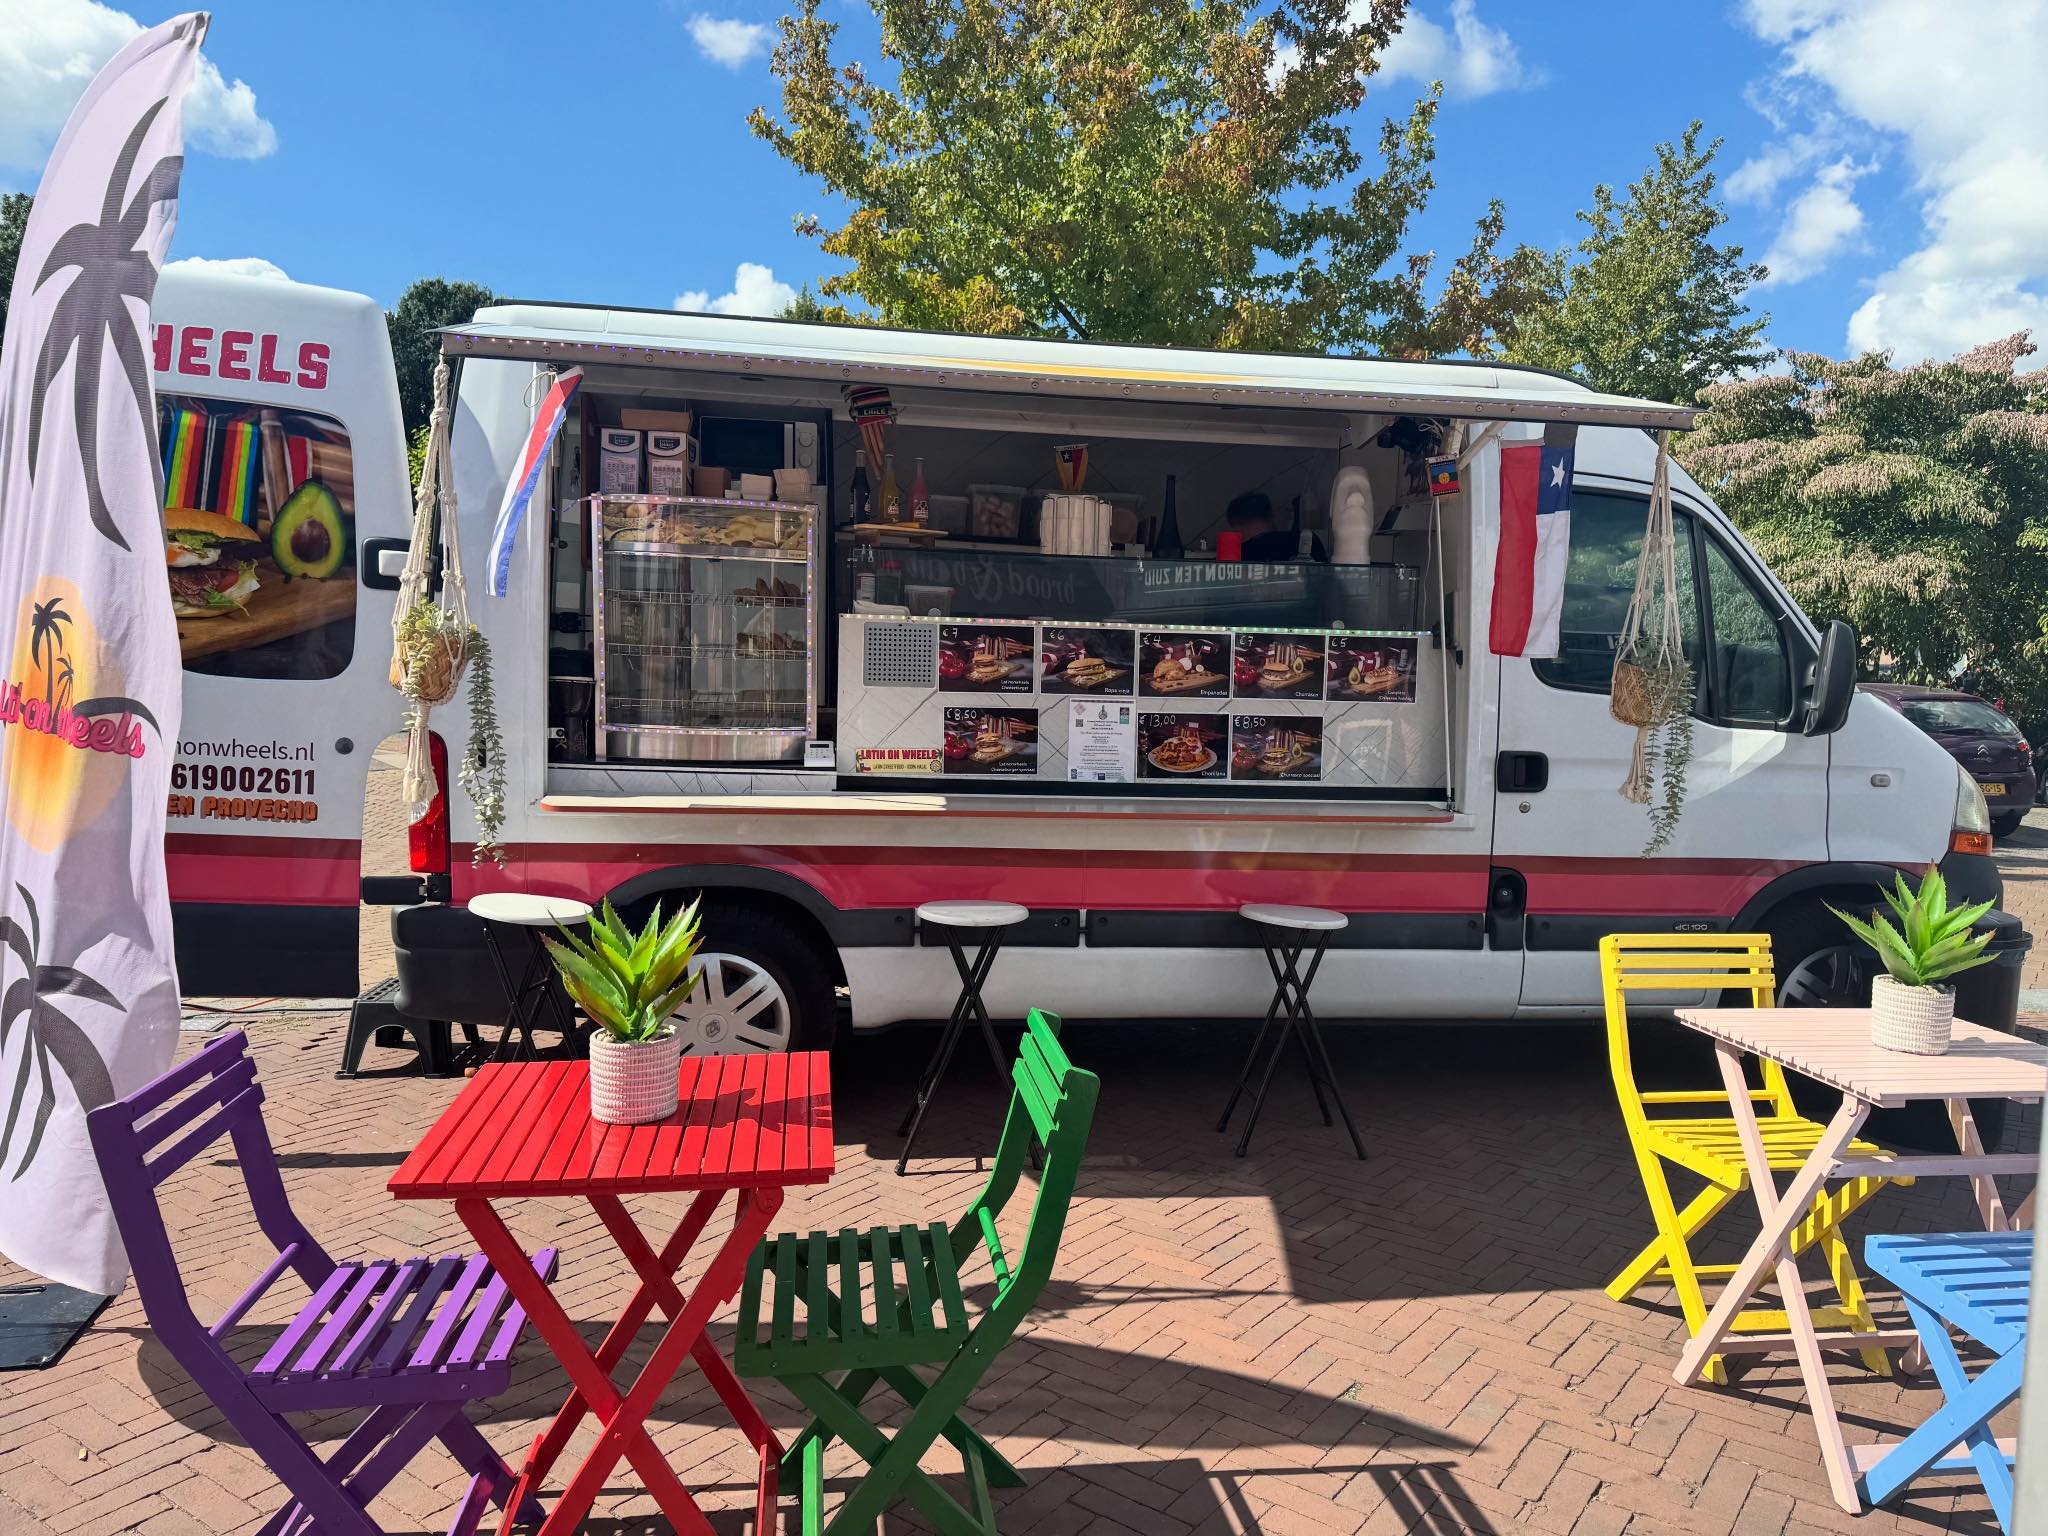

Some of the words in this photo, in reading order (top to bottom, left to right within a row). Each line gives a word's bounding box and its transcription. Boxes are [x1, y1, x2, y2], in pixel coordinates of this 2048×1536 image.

[861, 749, 886, 760] LATIN
[887, 749, 899, 760] ON
[902, 749, 938, 760] WHEELS
[171, 763, 315, 795] 619002611
[201, 796, 318, 822] PROVECHO
